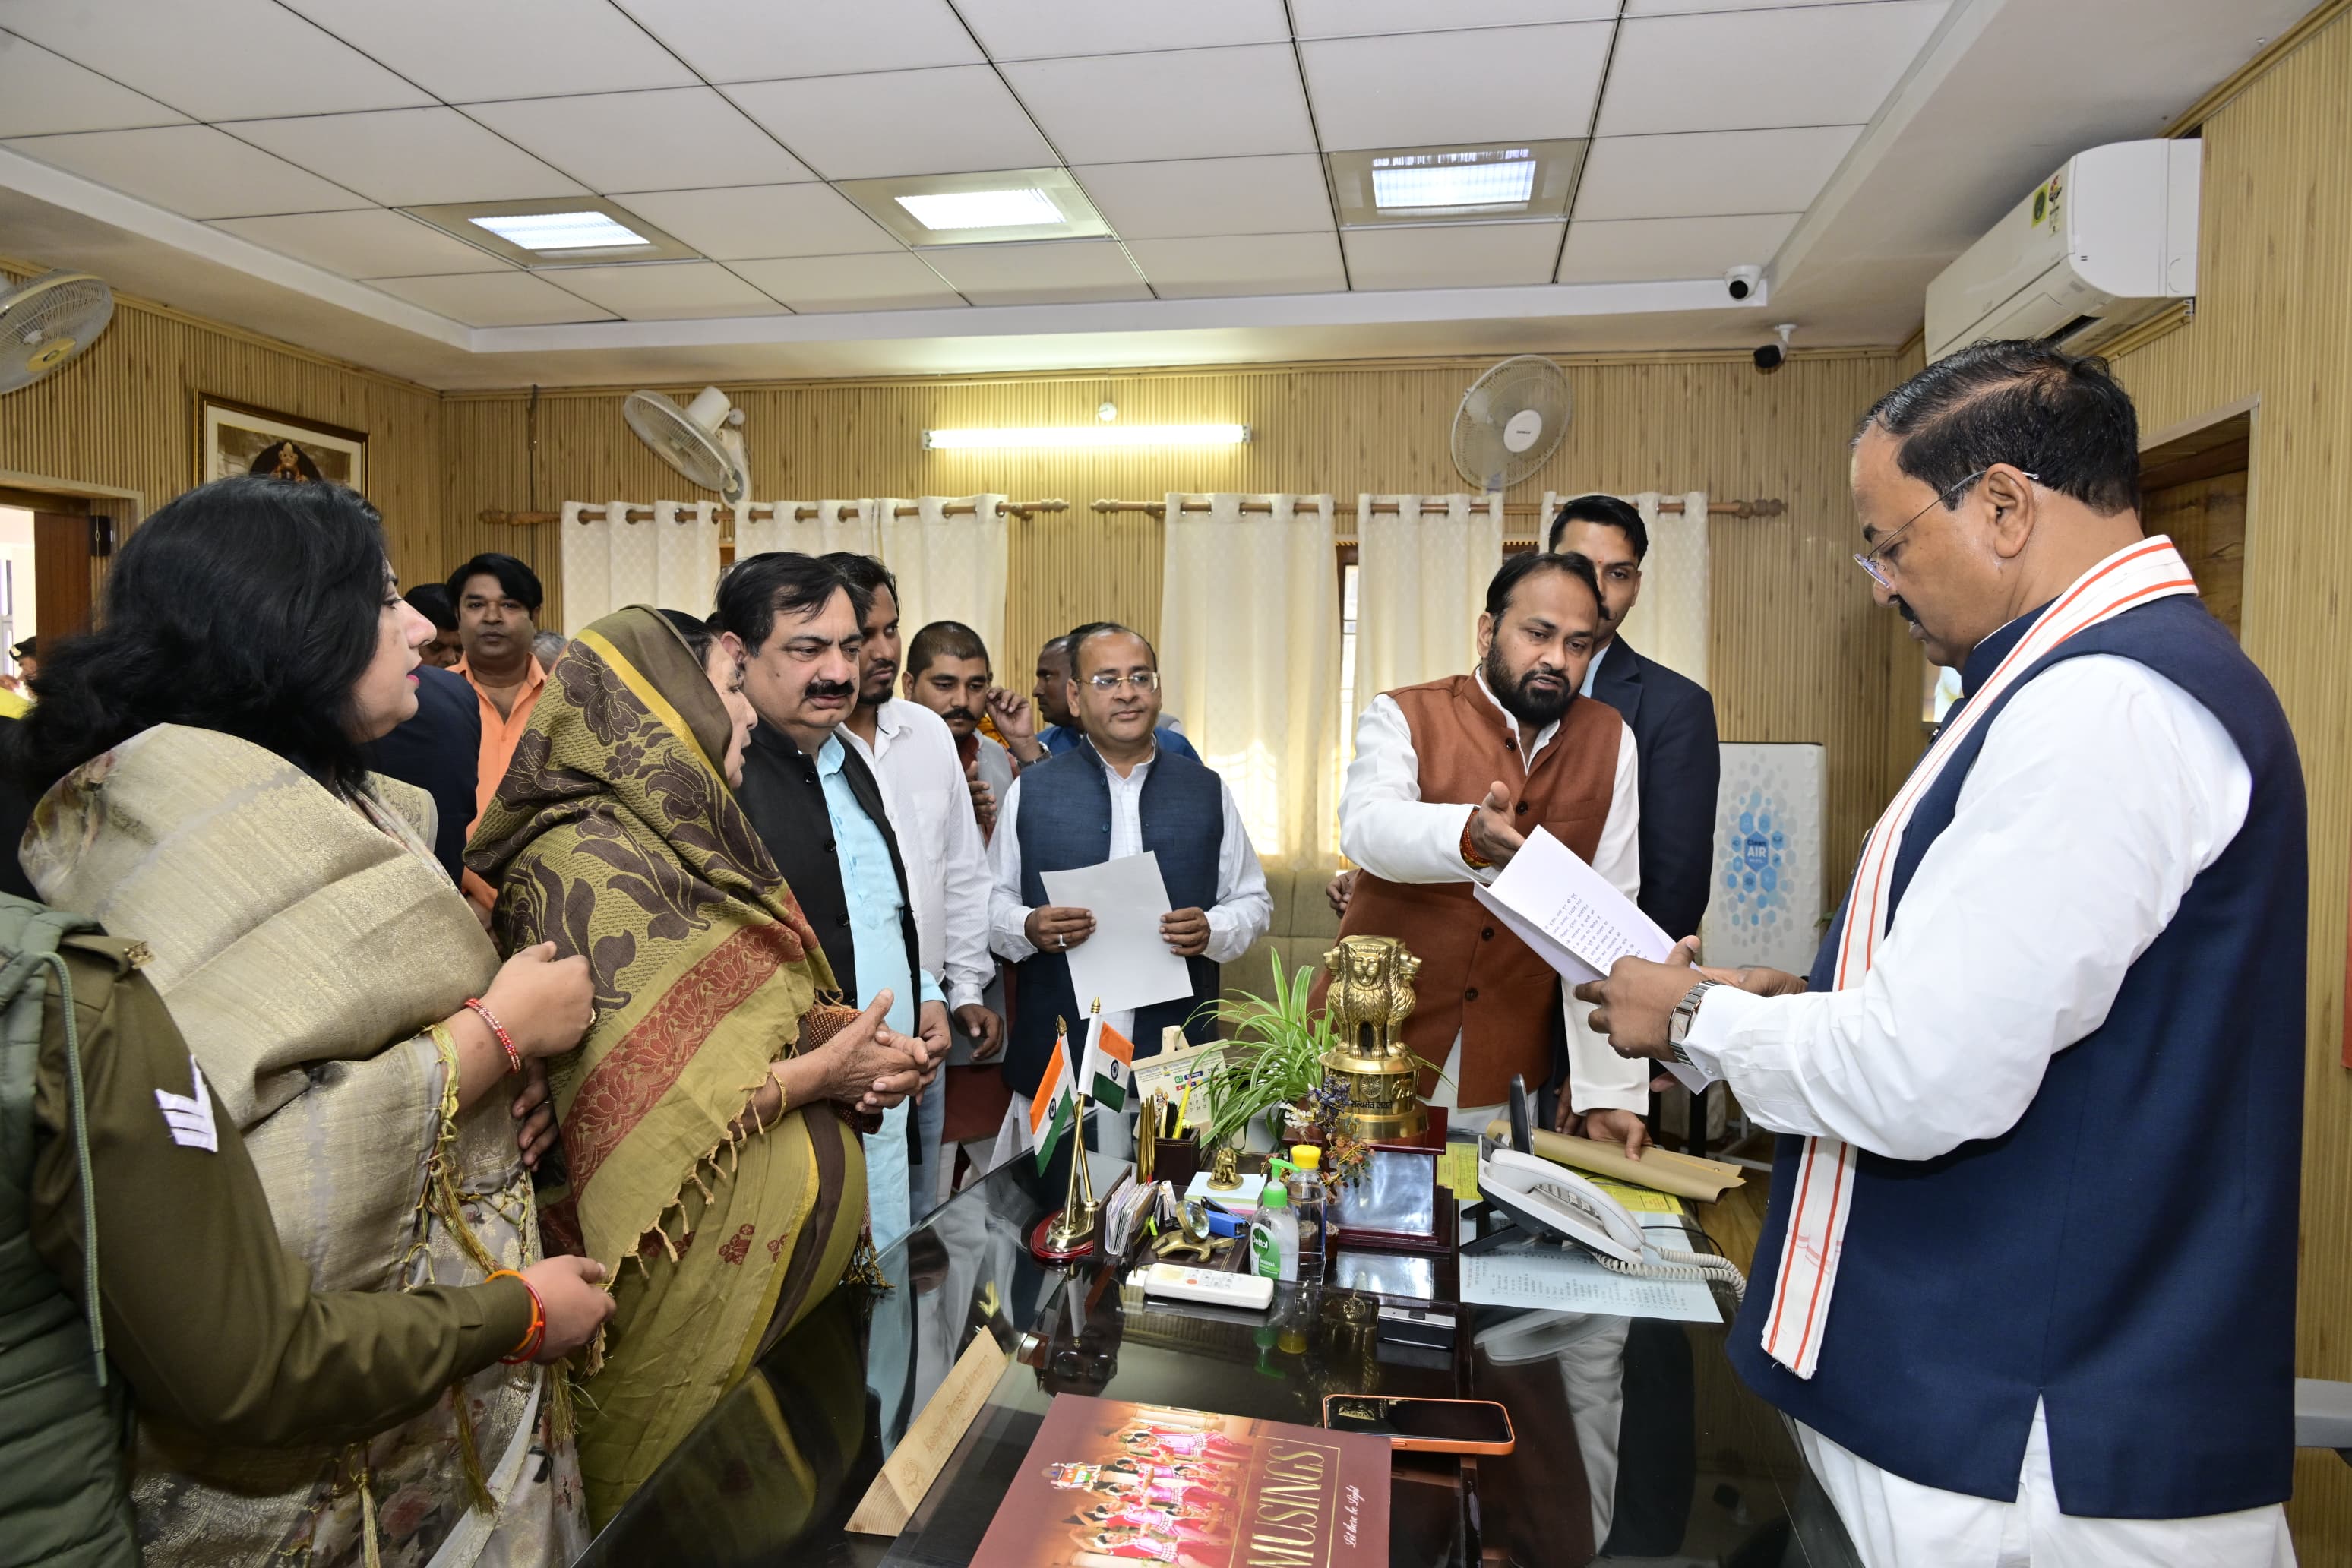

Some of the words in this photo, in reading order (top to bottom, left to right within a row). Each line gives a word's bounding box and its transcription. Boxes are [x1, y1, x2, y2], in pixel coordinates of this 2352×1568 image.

[1747, 846, 1766, 857] AIR
[1351, 1100, 1374, 1108] सत्यमेव
[1376, 1100, 1392, 1108] जयते
[1252, 1234, 1268, 1250] Dettol
[1247, 1445, 1324, 1568] MUSINGS
